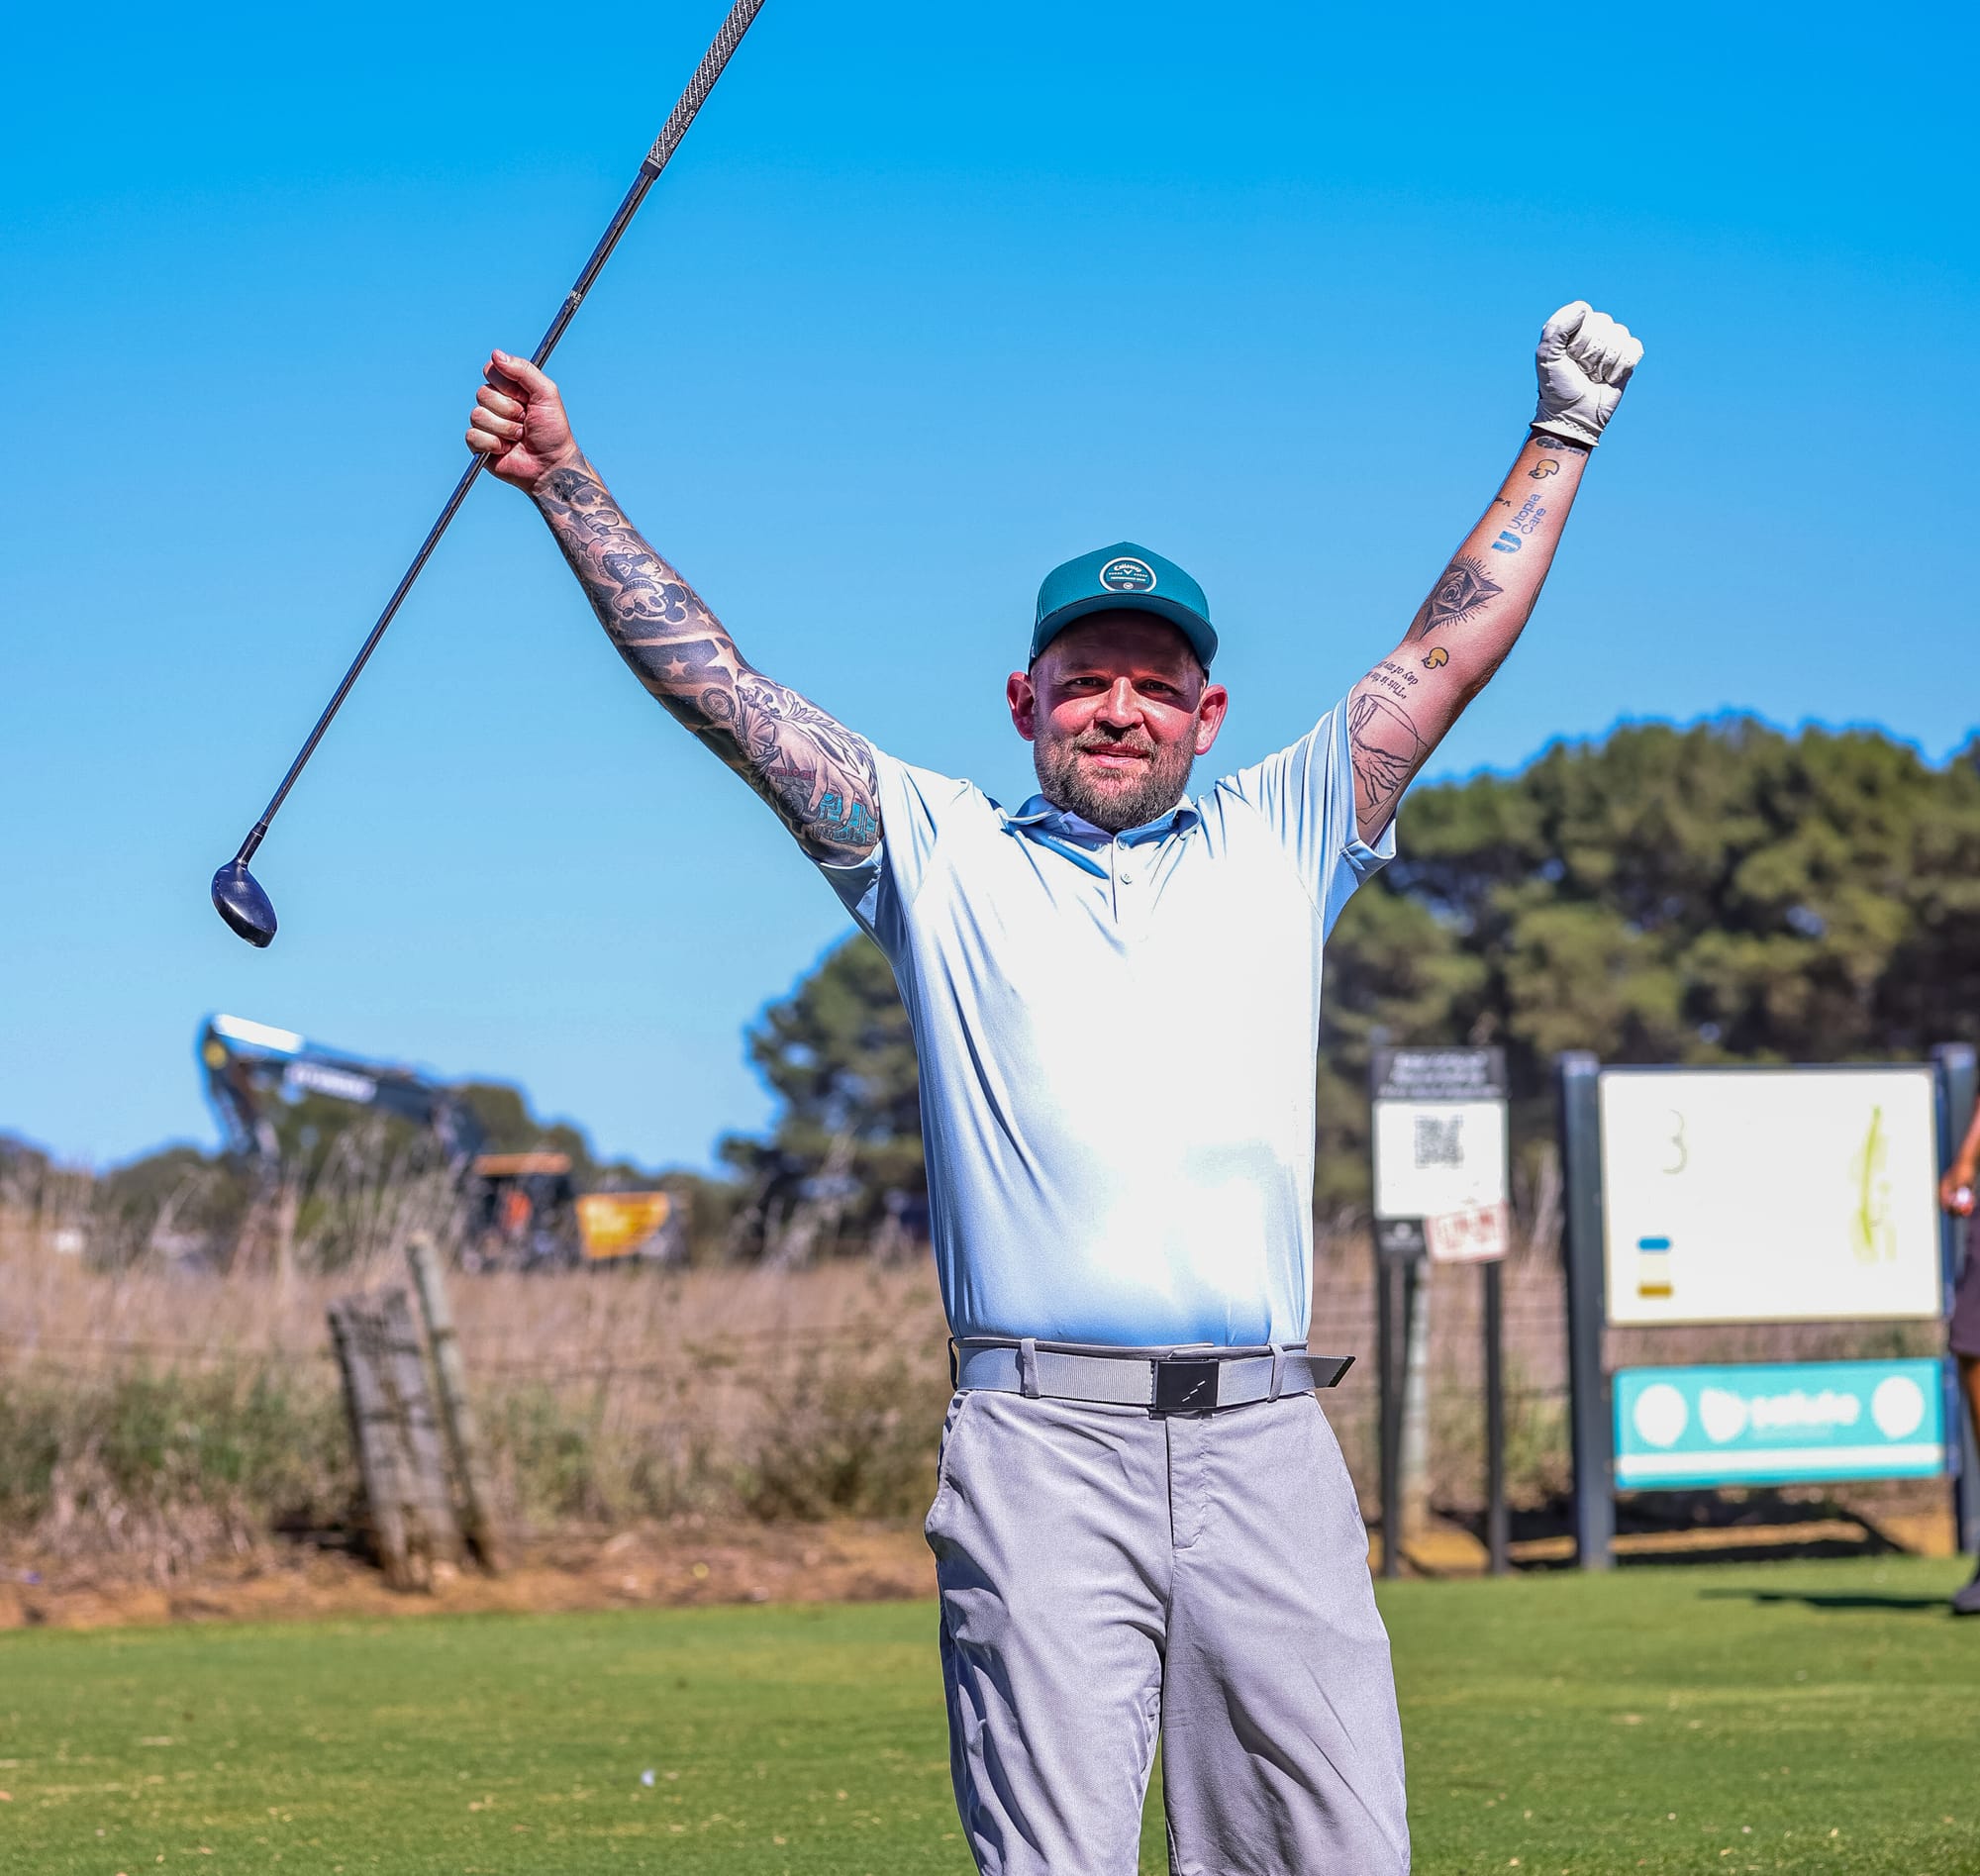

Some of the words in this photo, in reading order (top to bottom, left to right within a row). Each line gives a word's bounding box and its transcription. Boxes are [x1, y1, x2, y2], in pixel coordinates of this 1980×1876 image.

[1507, 493, 1541, 530] Utopia
[1521, 507, 1546, 535] Care
[1402, 670, 1419, 686] day
[1661, 1109, 1689, 1174] 3
